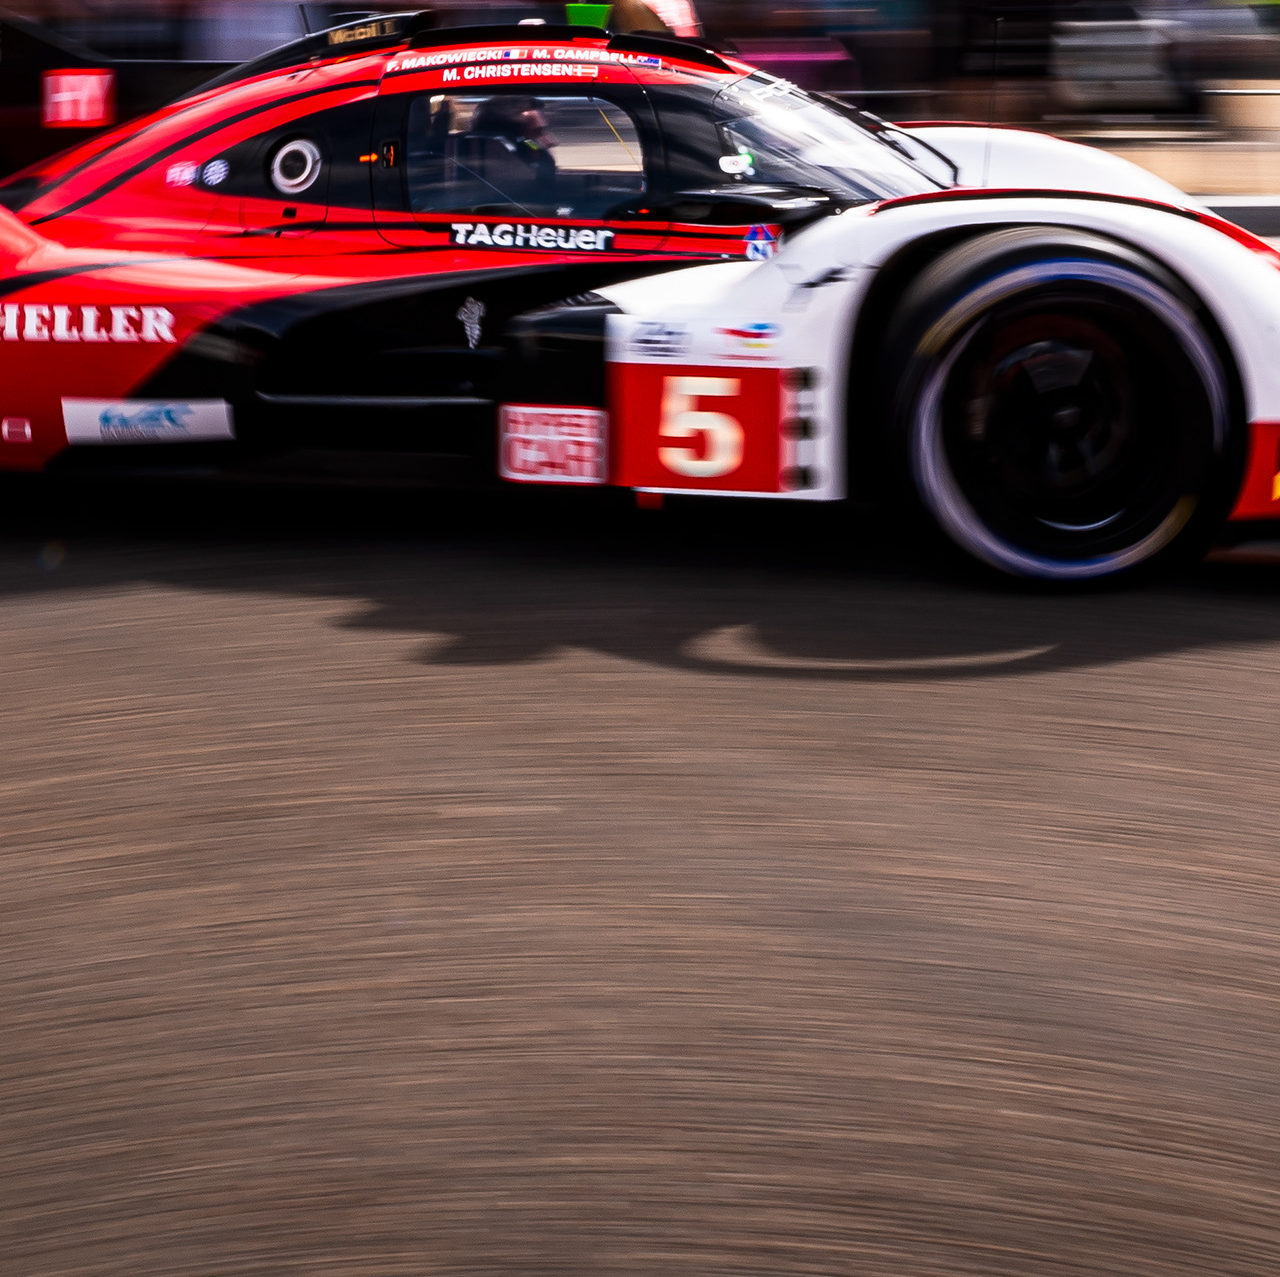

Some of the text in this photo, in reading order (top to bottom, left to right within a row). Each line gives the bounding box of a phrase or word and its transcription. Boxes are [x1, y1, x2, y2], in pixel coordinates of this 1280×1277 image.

[386, 50, 502, 72] F. MAKOWIECKI
[533, 49, 637, 63] M. CAMPBELL
[443, 64, 573, 82] M. CHRISTENSEN
[657, 376, 746, 478] 5
